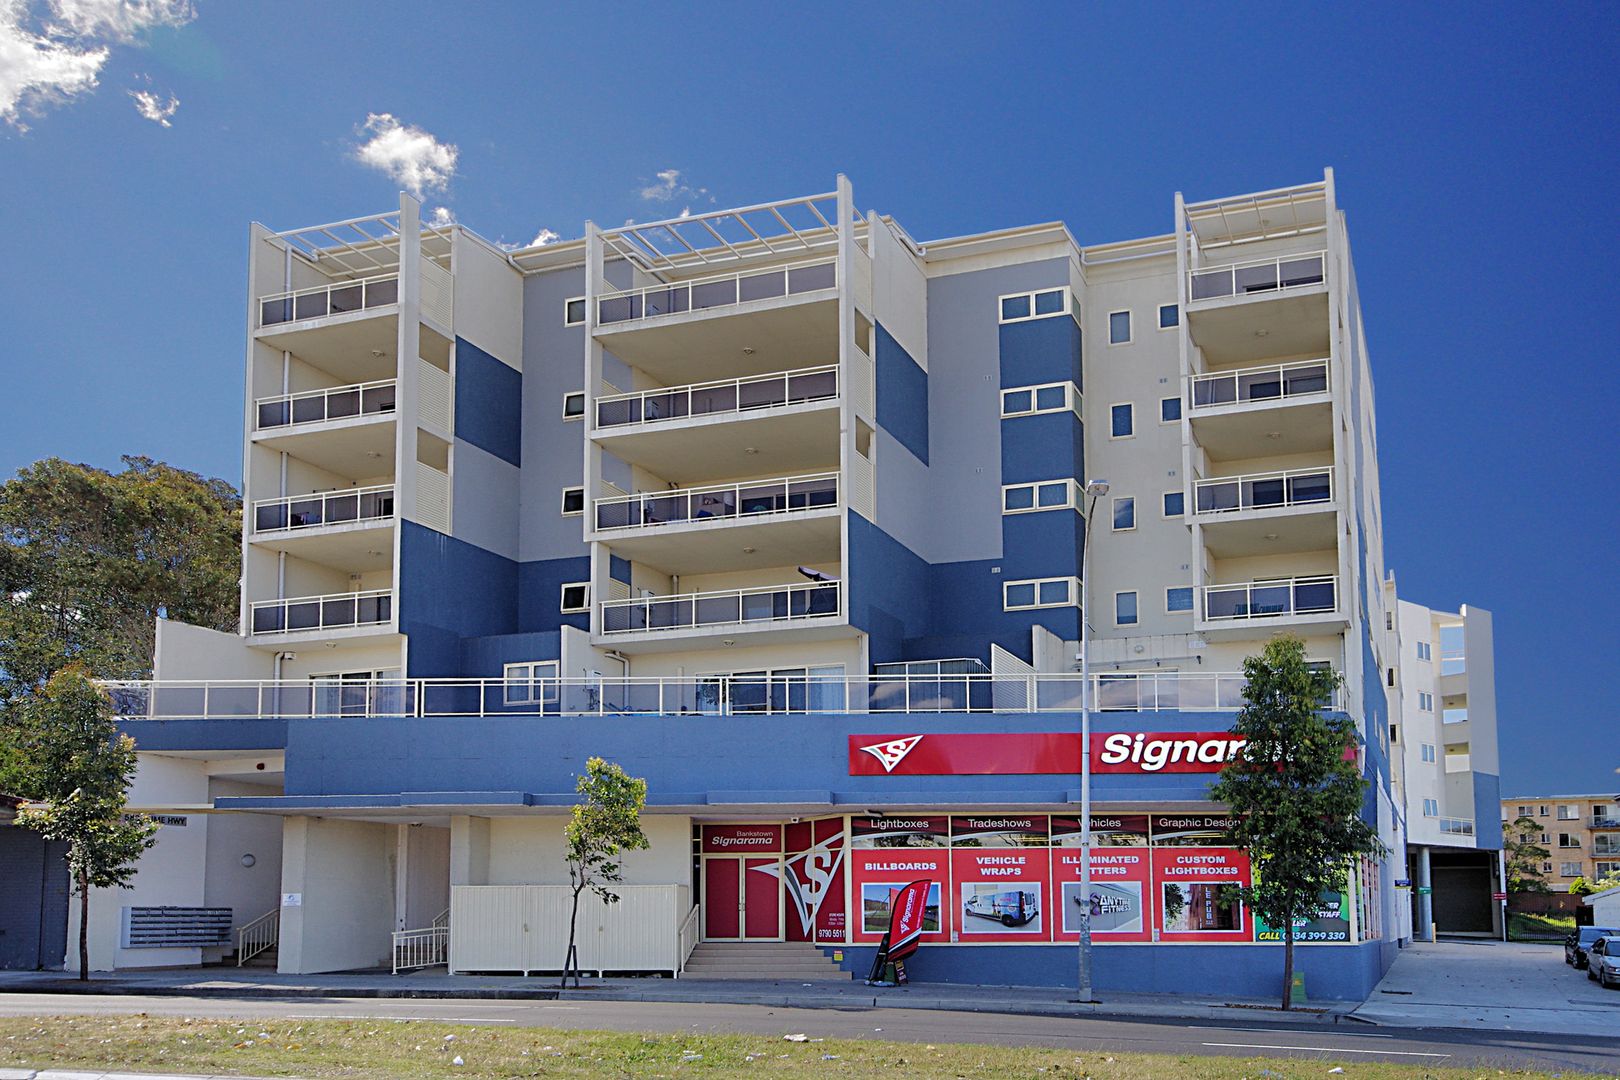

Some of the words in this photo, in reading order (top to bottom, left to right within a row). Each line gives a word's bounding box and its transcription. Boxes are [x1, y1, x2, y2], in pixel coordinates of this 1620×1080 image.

[167, 816, 185, 825] HWY
[870, 818, 930, 830] Lightboxes
[967, 818, 1032, 828] Tradeshows
[1077, 818, 1122, 828] Vhicles
[1159, 818, 1201, 829] Graphic
[711, 836, 773, 847] Signarama
[975, 856, 1026, 865] VEHICLE
[1062, 856, 1140, 864] ILLMINATED
[1176, 856, 1226, 864] CUSTOM
[864, 862, 937, 871] BILLBOARDS
[1075, 866, 1127, 875] LTTERS
[1164, 866, 1238, 875] LIGHTBOXES
[980, 867, 1022, 876] WRAPS
[818, 929, 832, 938] 9790
[1258, 932, 1280, 940] CALL
[1307, 931, 1327, 940] 399
[1327, 931, 1346, 940] 330
